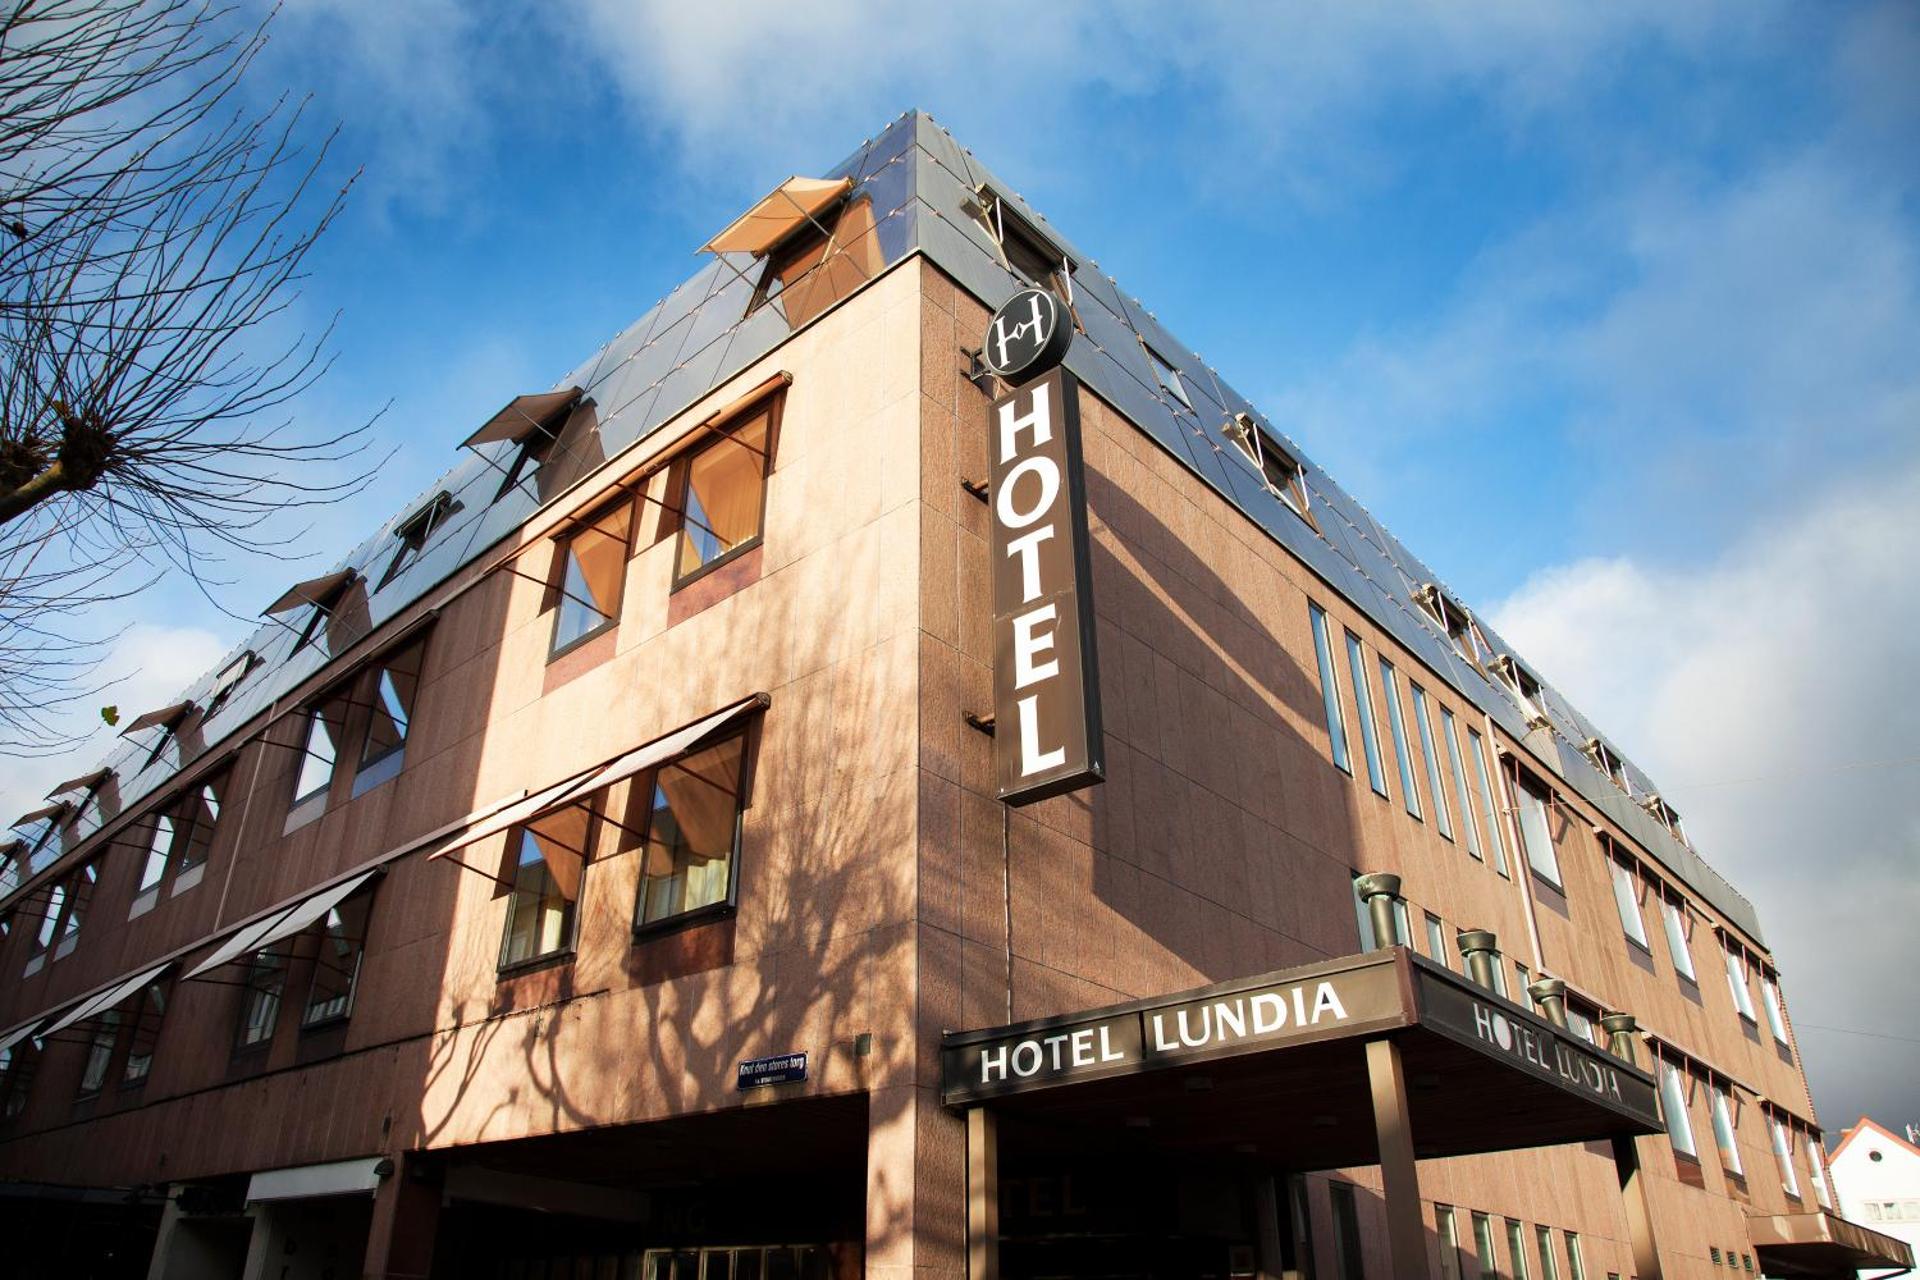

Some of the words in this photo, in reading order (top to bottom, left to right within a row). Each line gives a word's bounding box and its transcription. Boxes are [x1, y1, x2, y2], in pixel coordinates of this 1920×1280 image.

[996, 383, 1066, 778] HOTEL
[980, 1026, 1125, 1084] HOTEL
[1152, 981, 1349, 1052] LUNDIA
[1473, 1002, 1550, 1070] HOTEL
[1554, 1043, 1623, 1102] LUNDIA
